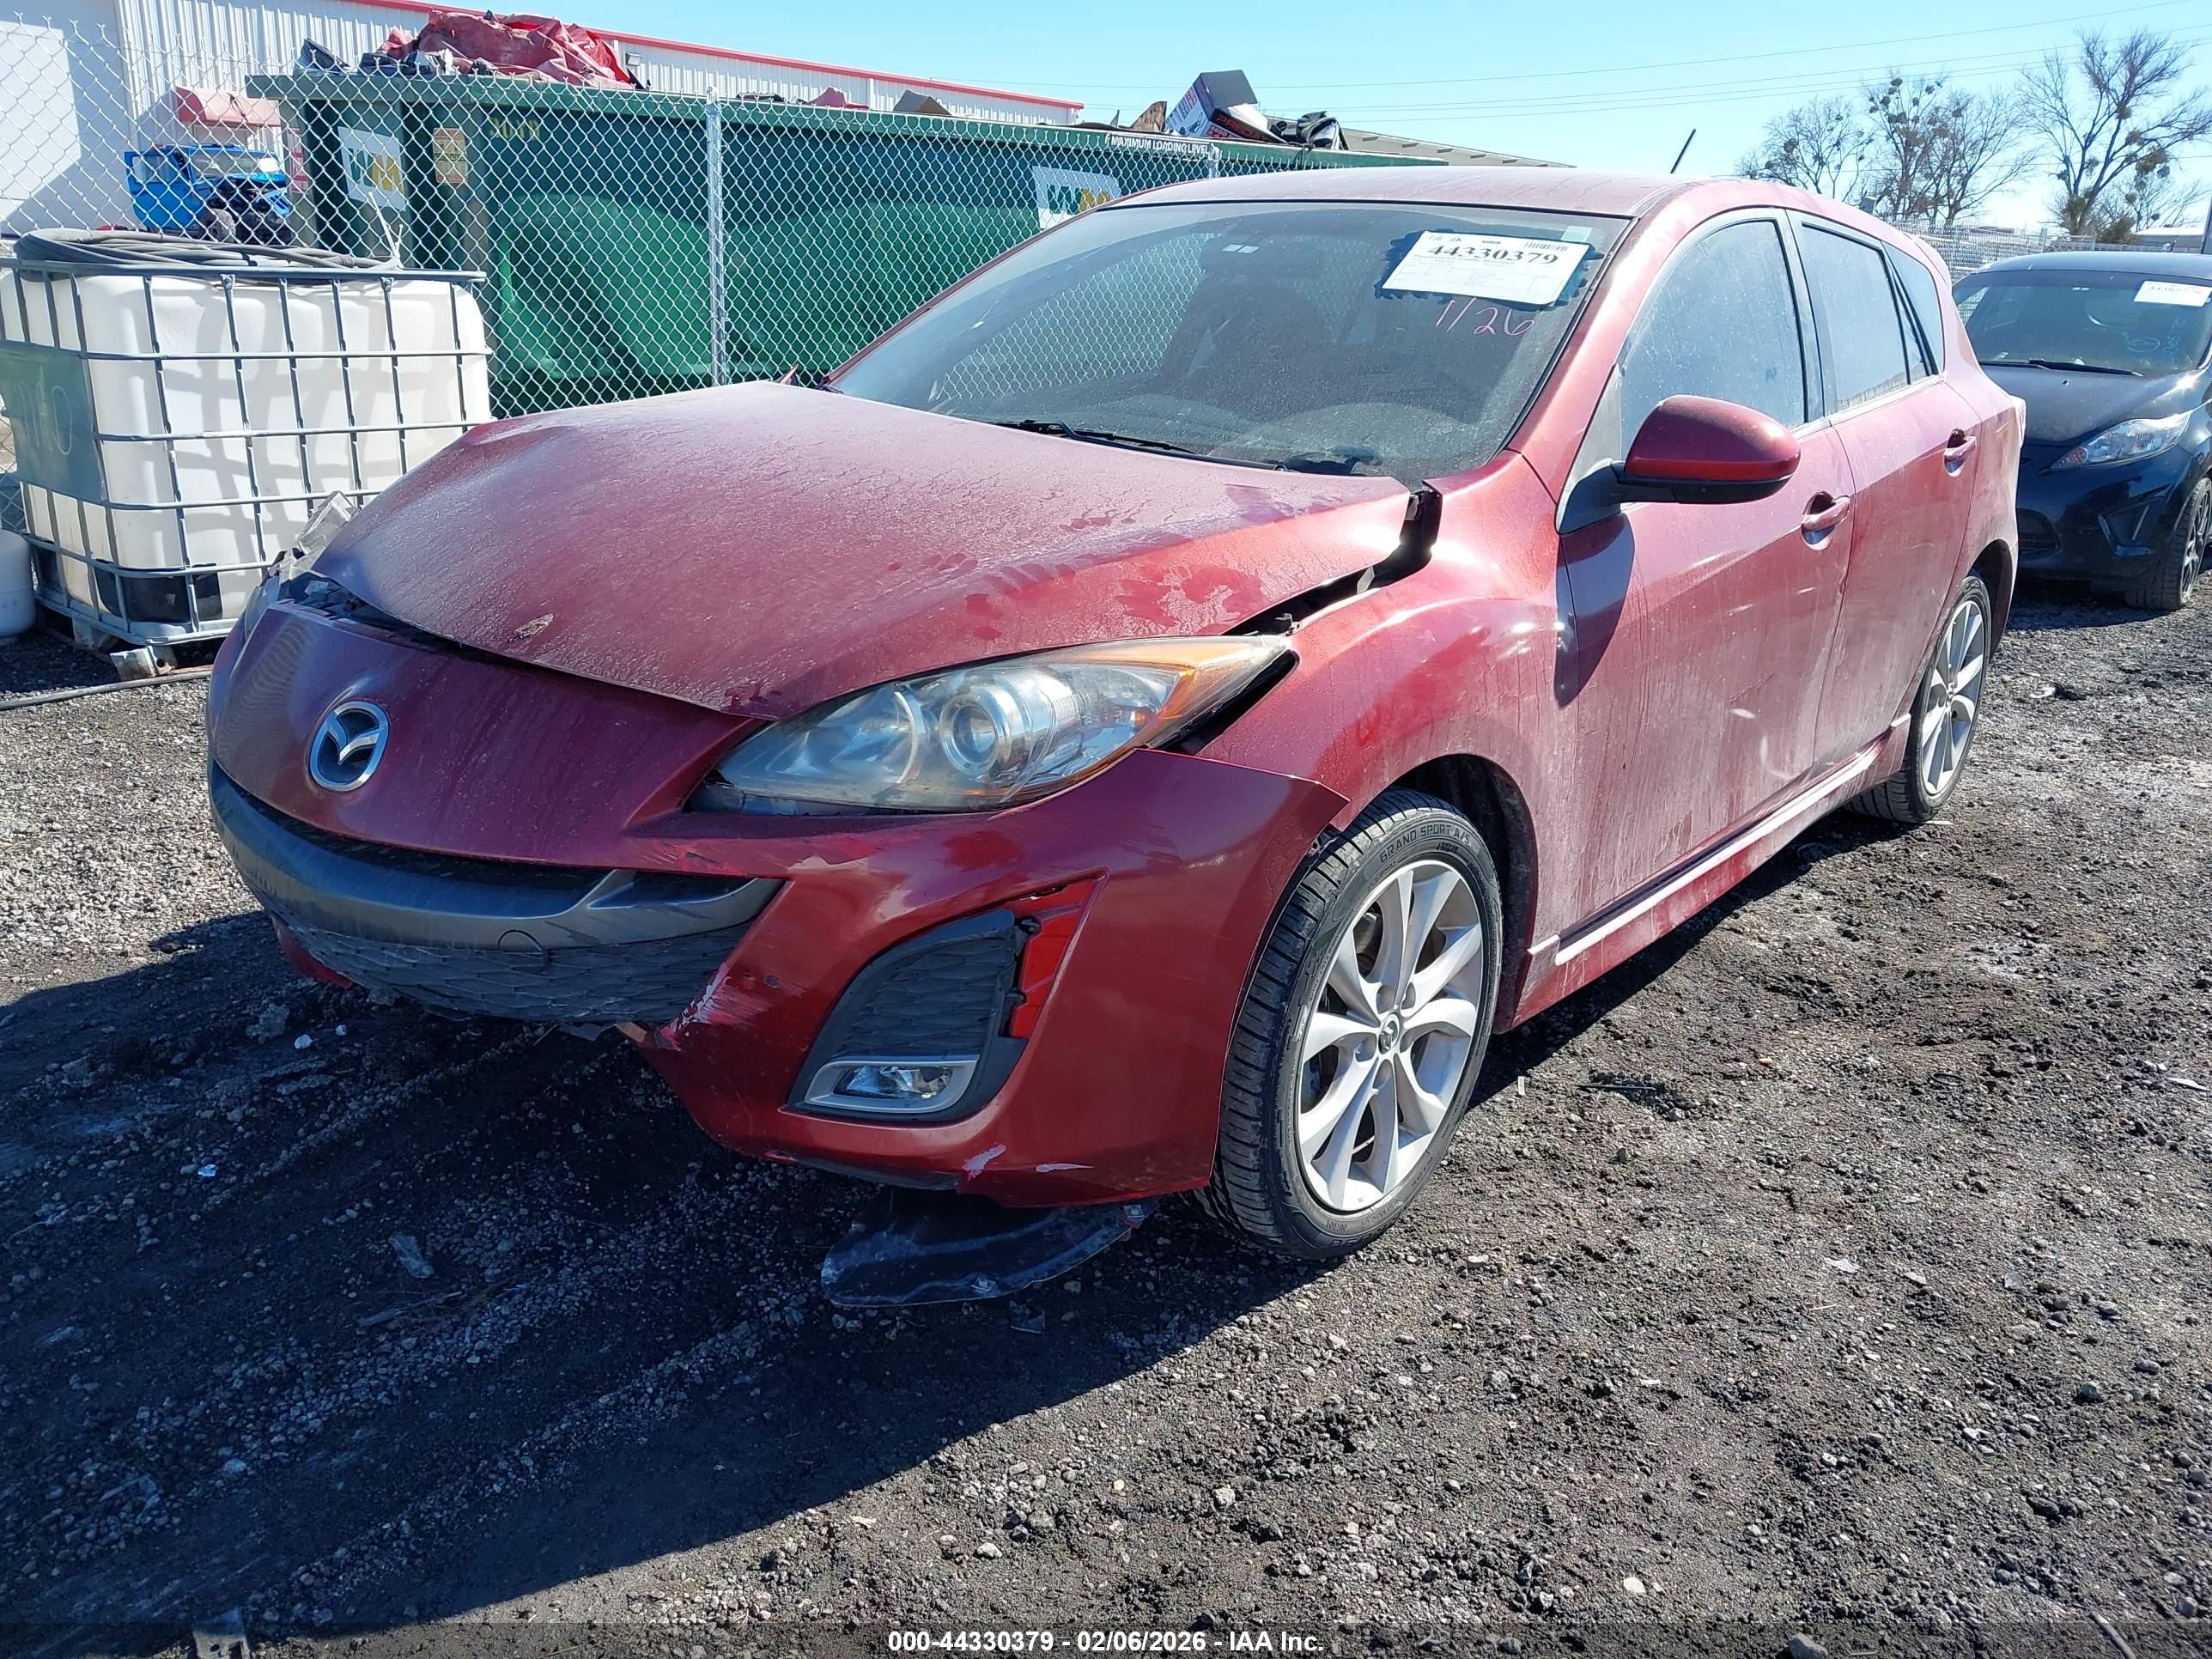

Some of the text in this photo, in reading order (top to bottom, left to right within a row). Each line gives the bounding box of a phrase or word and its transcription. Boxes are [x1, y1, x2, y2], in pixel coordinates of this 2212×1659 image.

[1111, 136, 1152, 149] MAXIMUM
[1153, 141, 1188, 153] LOADING
[348, 147, 404, 194] WM
[1427, 245, 1559, 264] 44330379
[1435, 296, 1535, 336] 1/26
[1379, 830, 1417, 863] GRAND
[1420, 823, 1451, 836] SPORT
